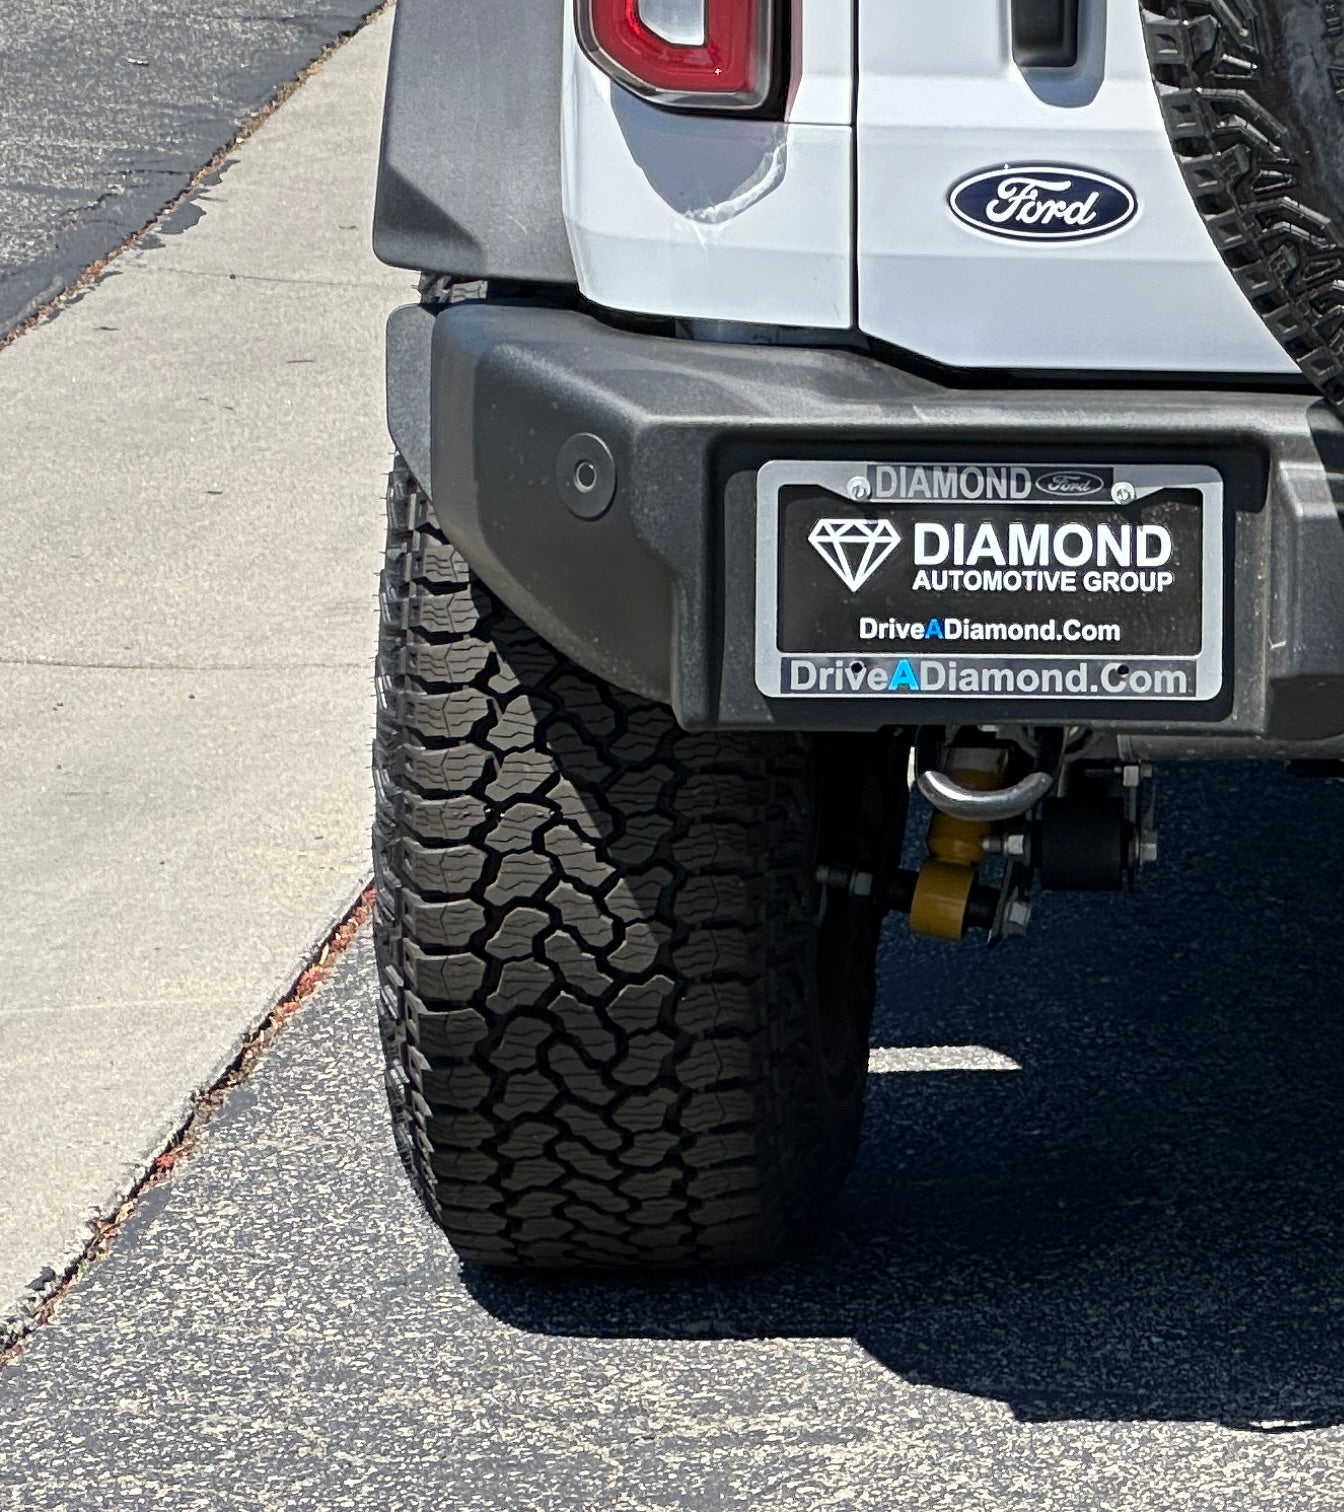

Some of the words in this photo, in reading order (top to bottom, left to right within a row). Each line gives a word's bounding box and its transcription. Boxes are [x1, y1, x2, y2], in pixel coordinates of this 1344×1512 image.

[985, 177, 1099, 225] Ford
[876, 465, 1032, 500] DIAMOND
[912, 522, 1173, 568] DIAMOND
[912, 570, 1077, 592] AUTOMOTIVE
[1083, 571, 1174, 593] GROUP
[859, 618, 1121, 642] DriveADiamond.Com
[790, 659, 1188, 694] DriveADiamond.Com
